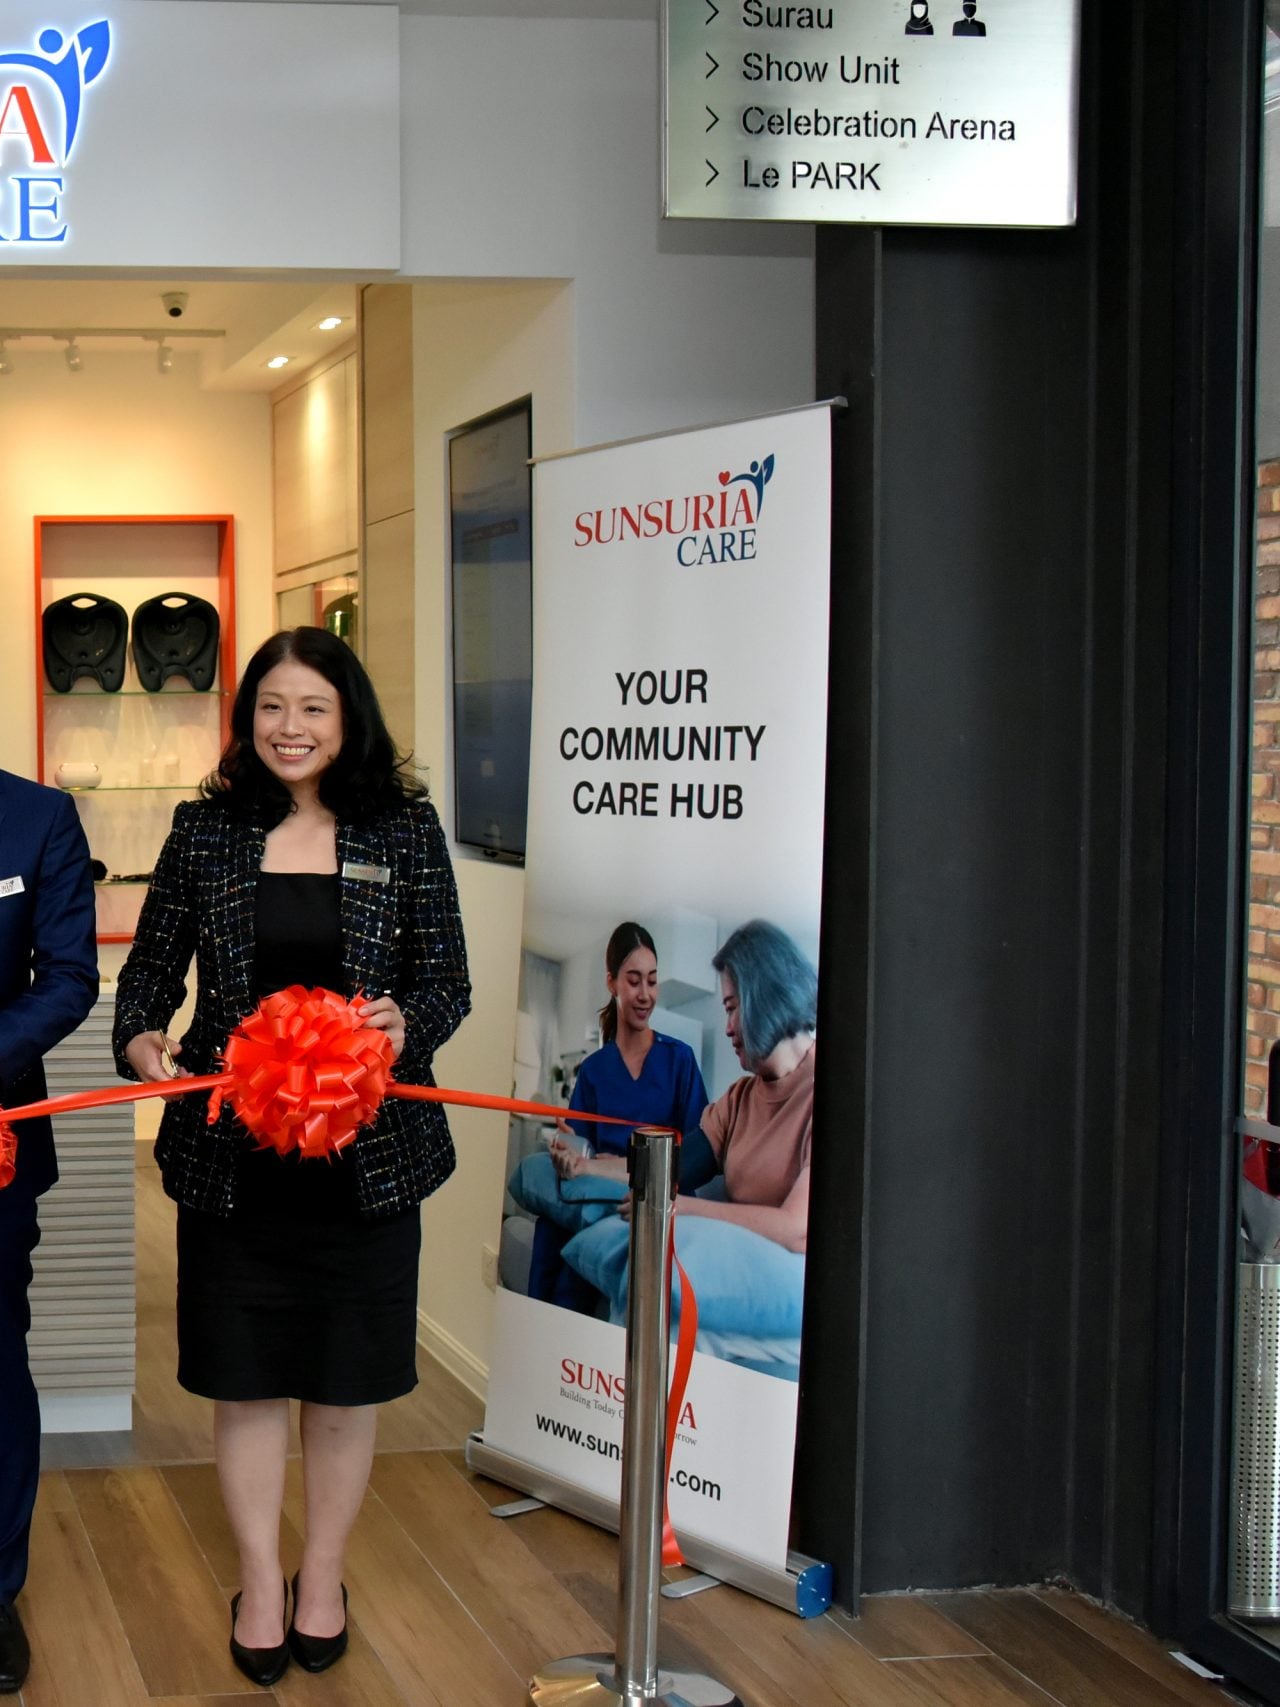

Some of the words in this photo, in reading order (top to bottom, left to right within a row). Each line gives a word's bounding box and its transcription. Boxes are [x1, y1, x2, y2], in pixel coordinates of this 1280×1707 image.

[742, 0, 833, 29] Surau
[742, 52, 828, 82] Show
[840, 55, 900, 84] Unit
[742, 106, 917, 138] Celebration
[925, 111, 1016, 141] Arena
[743, 160, 780, 188] Le
[791, 161, 881, 190] PARK
[574, 487, 755, 547] SUNSURIA
[677, 529, 757, 567] CARE
[615, 669, 708, 706] YOUR
[559, 726, 767, 762] COMMUNITY
[573, 781, 659, 817] CARE
[671, 783, 744, 820] HUB
[560, 1387, 591, 1410] Building
[593, 1399, 616, 1418] Today
